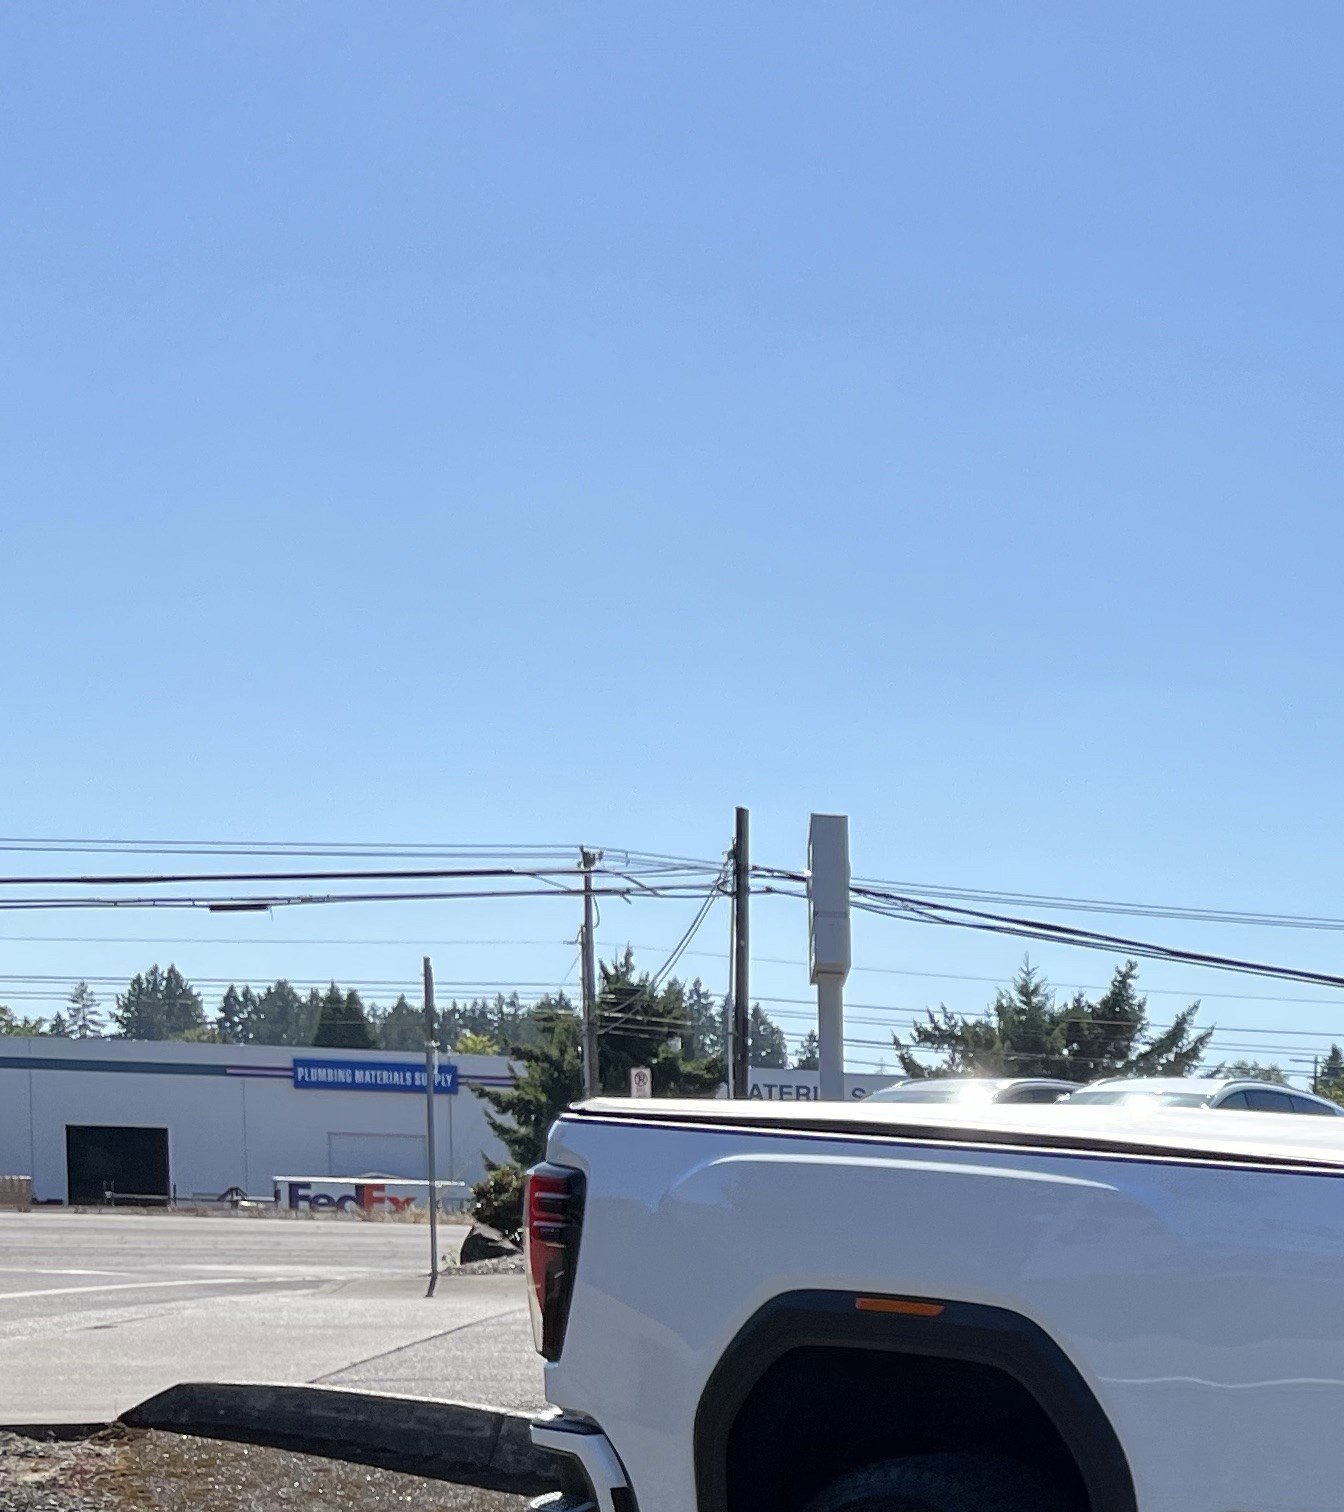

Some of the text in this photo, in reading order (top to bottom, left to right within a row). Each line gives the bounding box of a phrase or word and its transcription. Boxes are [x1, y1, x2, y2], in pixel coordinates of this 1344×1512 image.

[297, 1067, 452, 1087] PLUMBING MATERIALS SUPLY
[289, 1184, 417, 1213] FedEx
